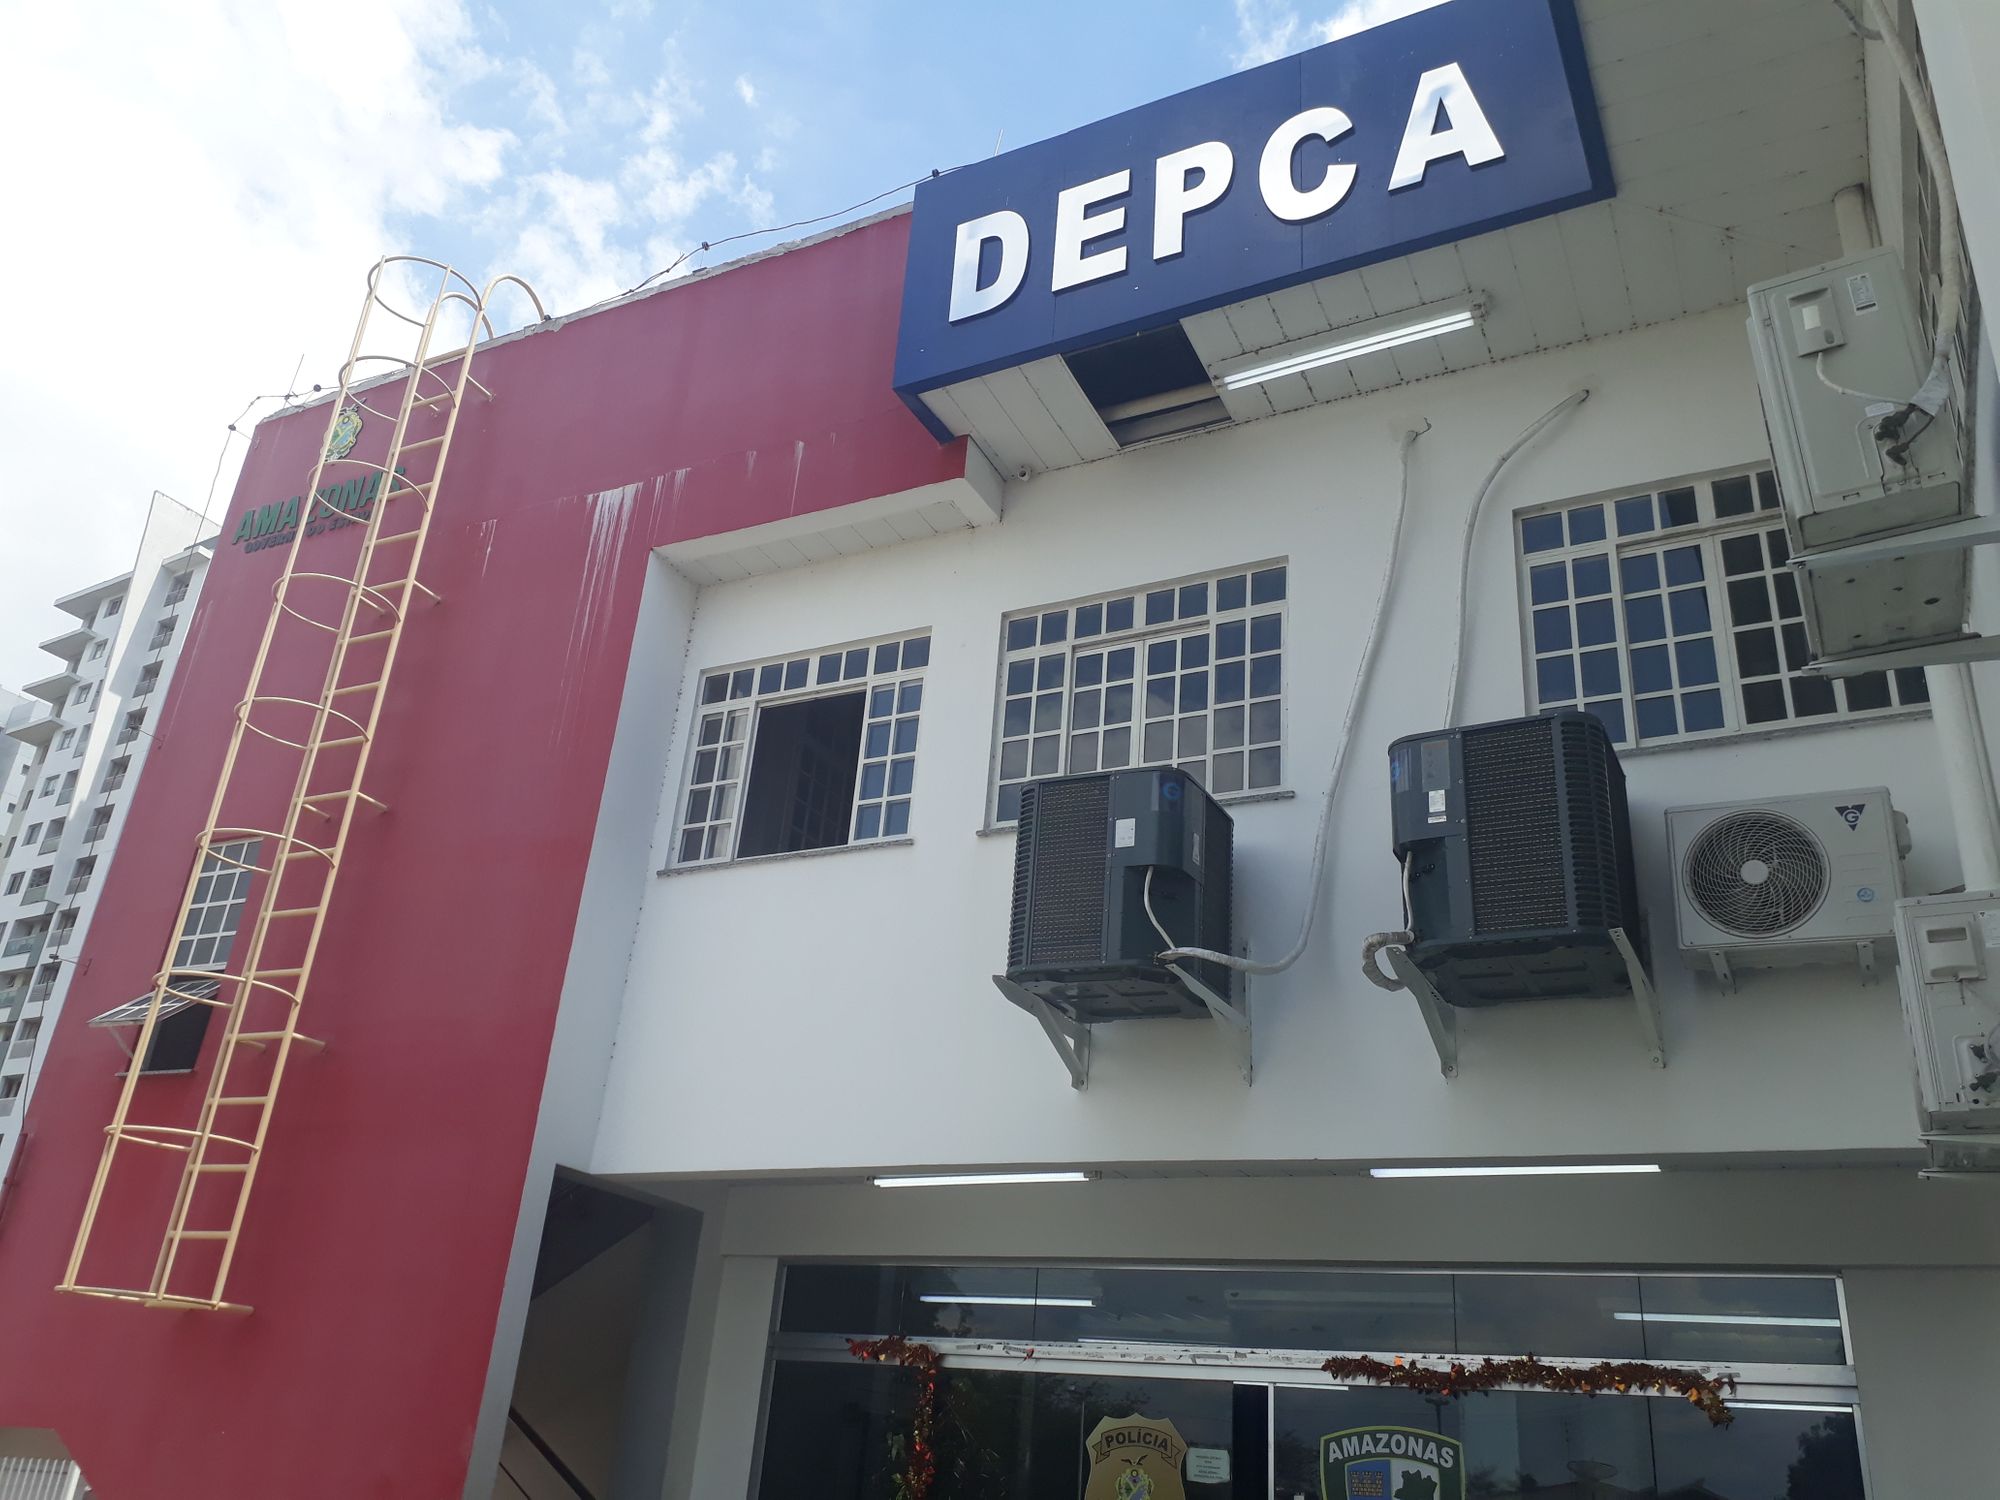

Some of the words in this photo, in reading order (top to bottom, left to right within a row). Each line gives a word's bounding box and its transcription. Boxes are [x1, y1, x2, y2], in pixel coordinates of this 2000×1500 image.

[948, 62, 1505, 323] DEPCA
[1105, 1429, 1169, 1451] POLÍCIA
[1328, 1433, 1454, 1468] AMAZONAS
